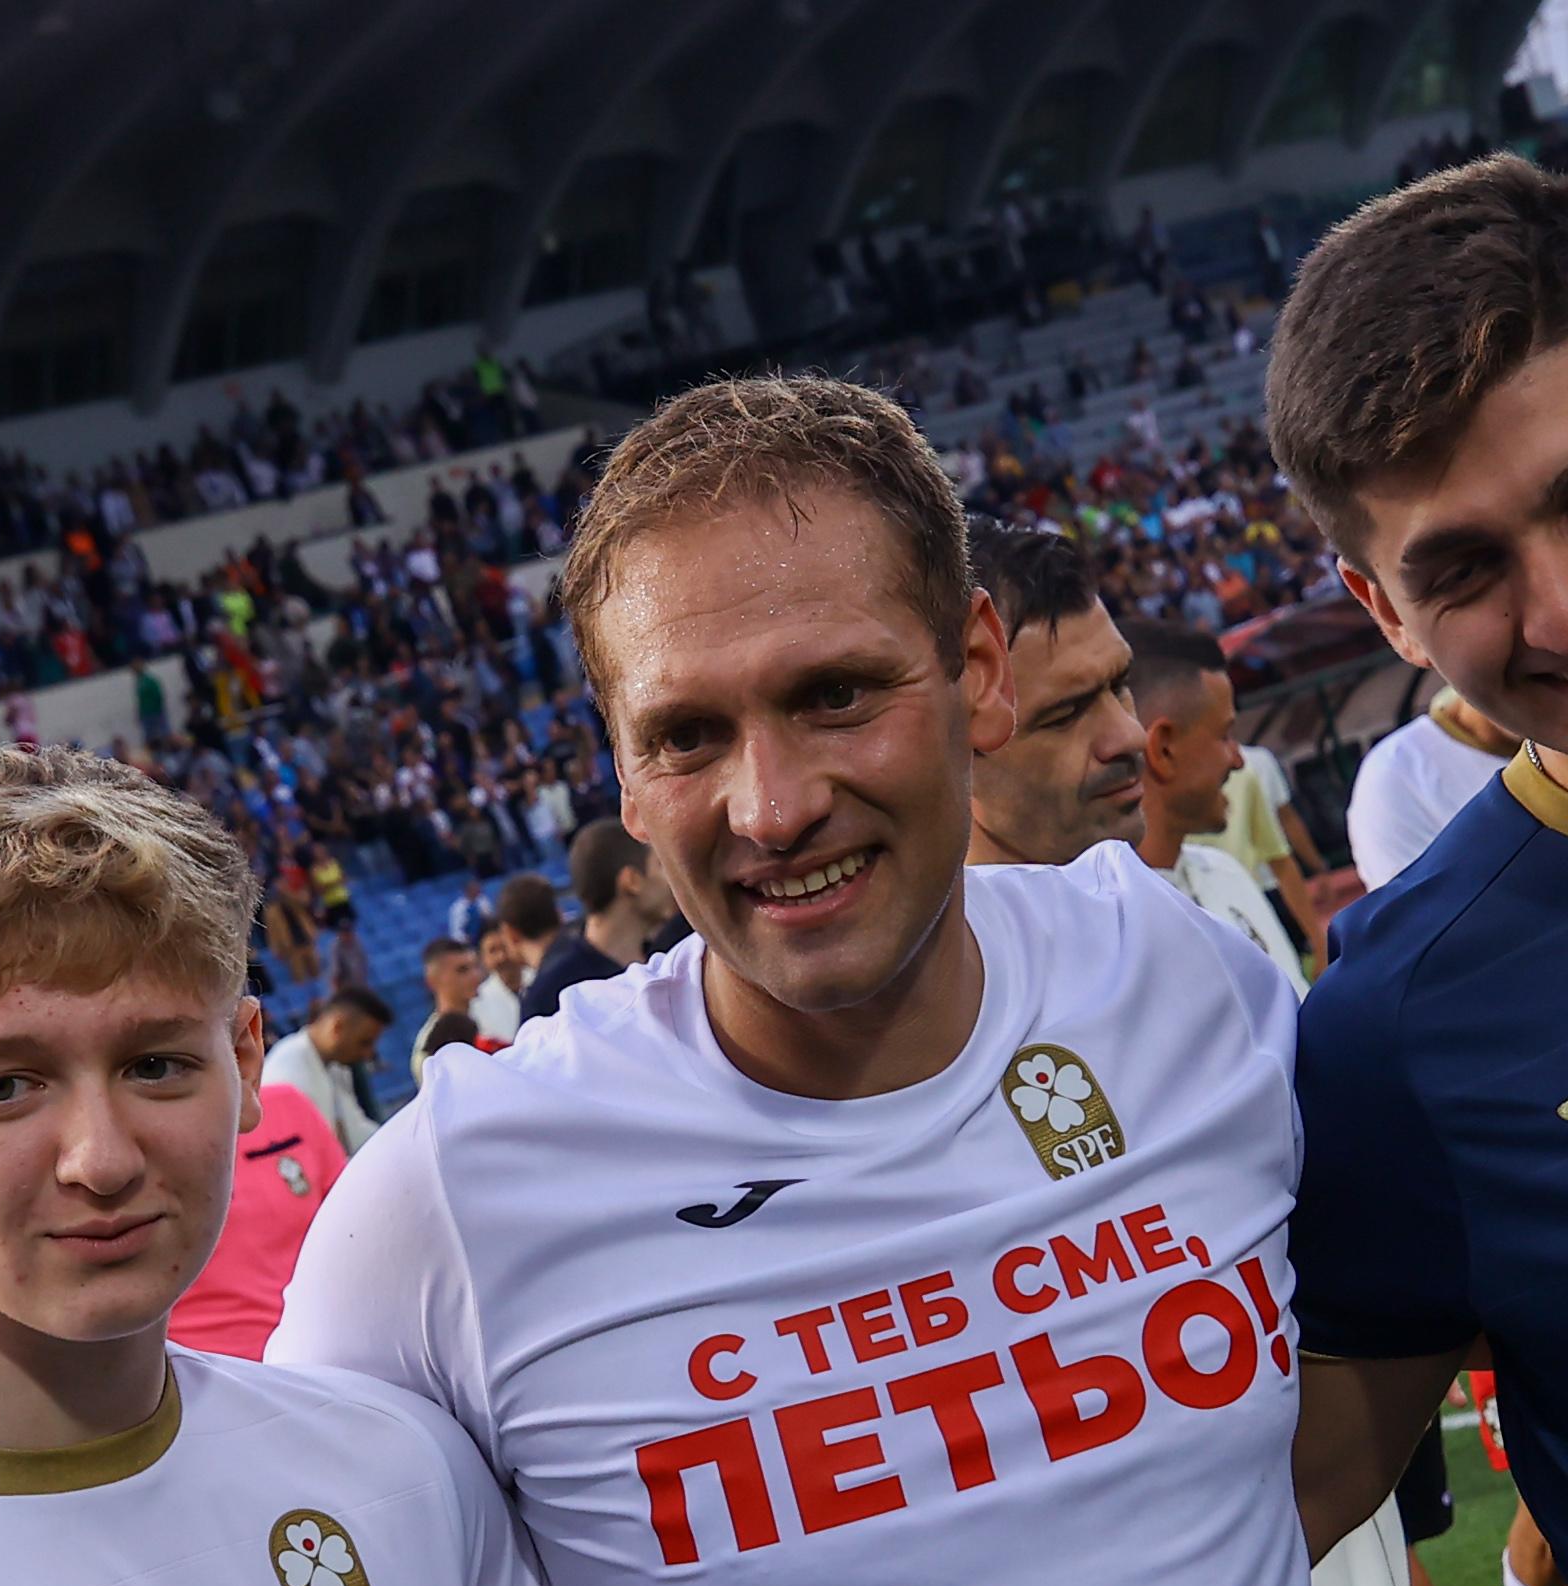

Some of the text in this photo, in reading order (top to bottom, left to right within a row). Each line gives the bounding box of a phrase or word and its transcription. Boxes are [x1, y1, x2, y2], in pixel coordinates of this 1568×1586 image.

[1052, 1123, 1116, 1179] SPF
[775, 1271, 970, 1374] ТЕБ
[993, 1204, 1214, 1315] СМЕ,
[636, 1257, 1292, 1566] ПЕТЬО!
